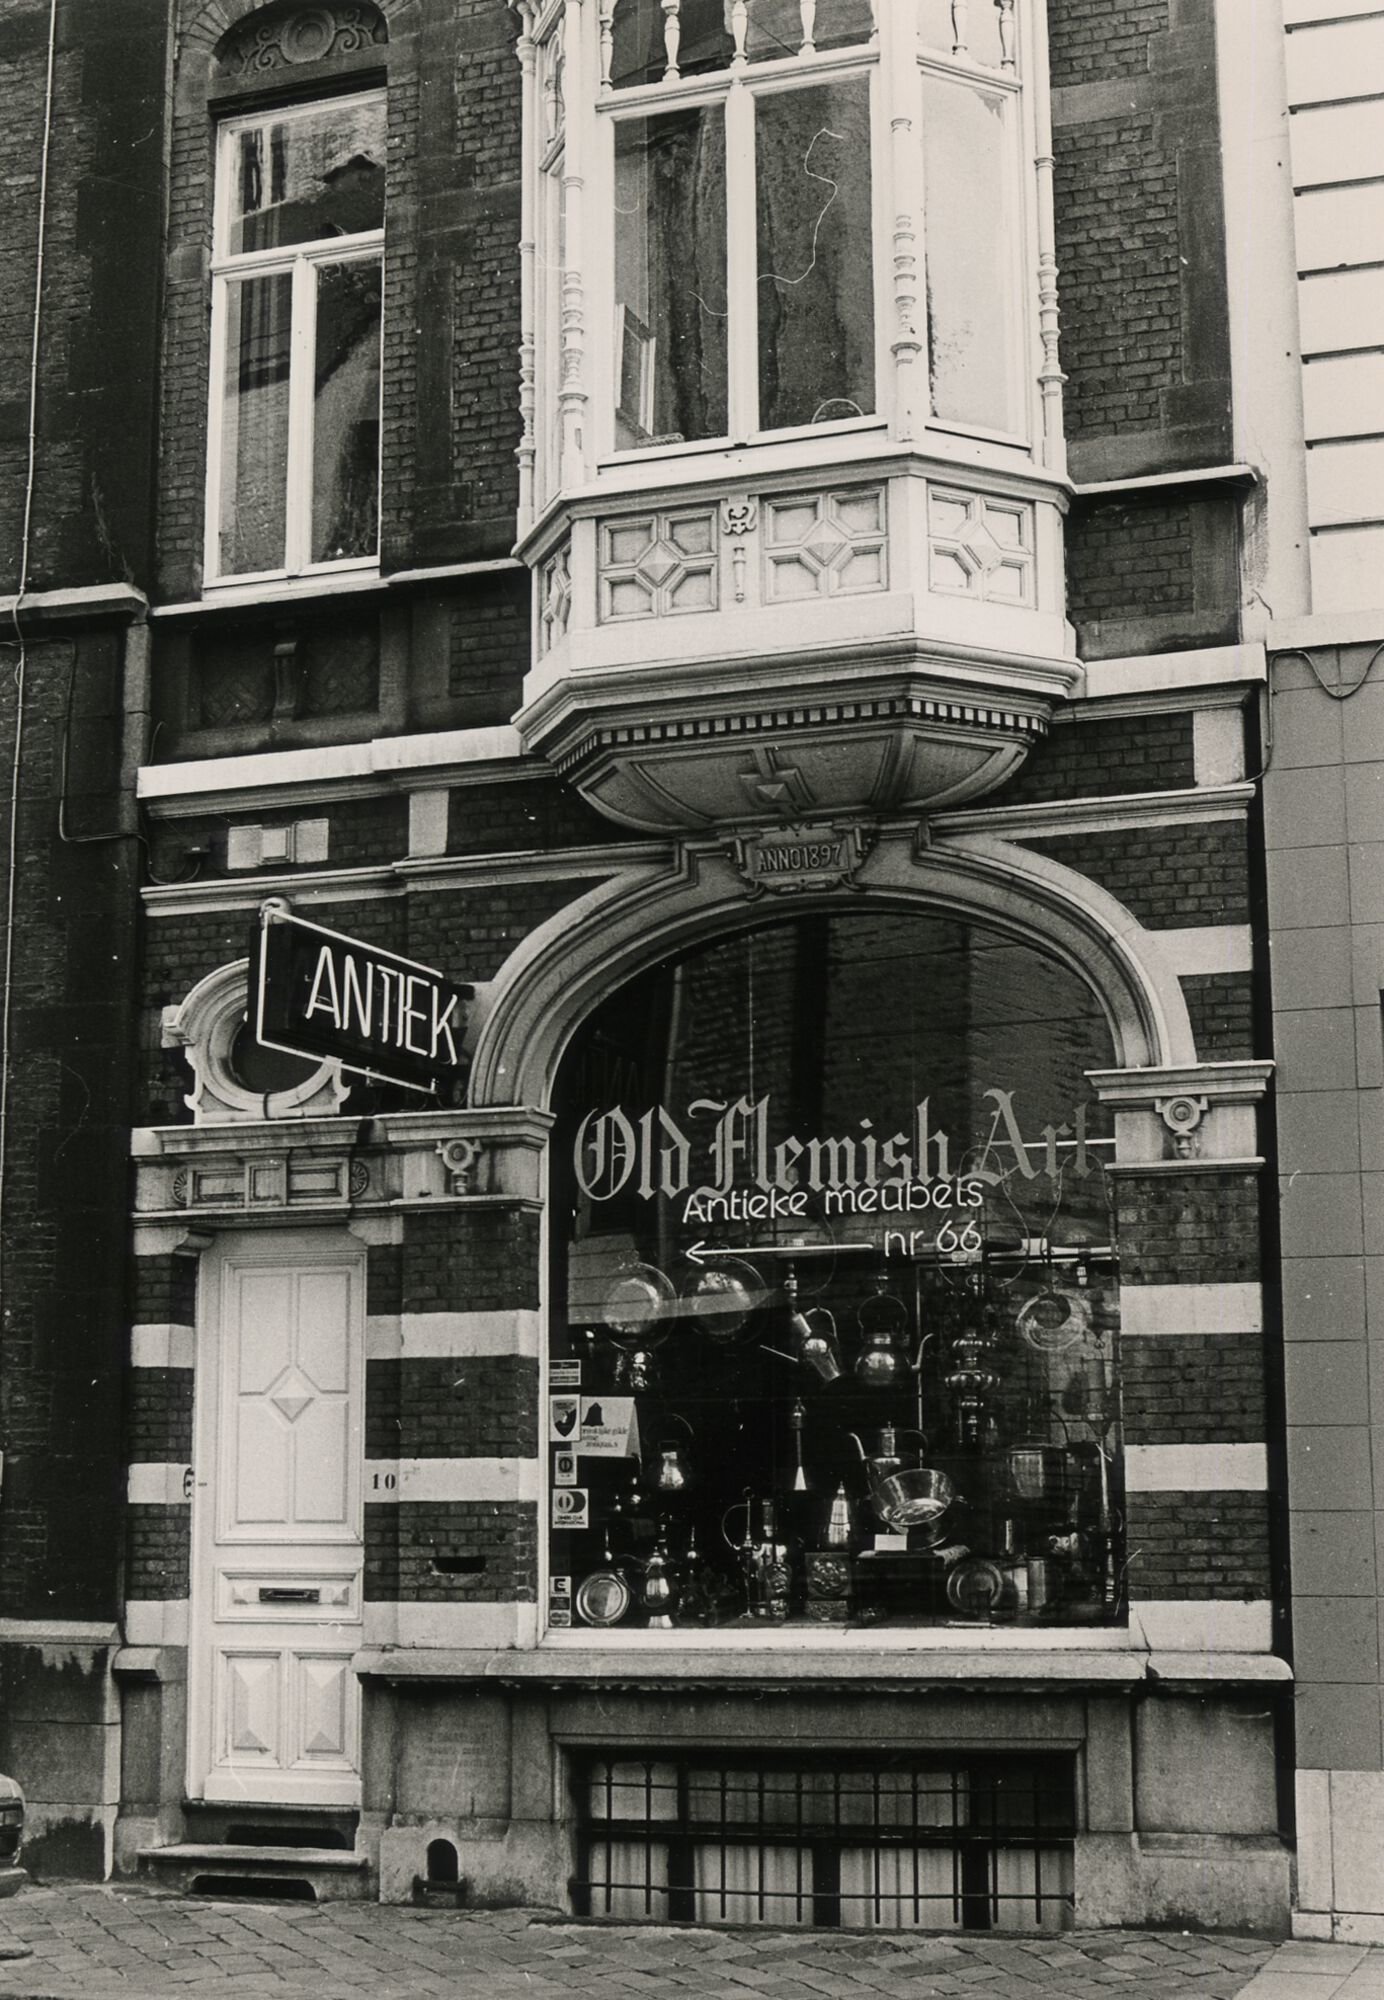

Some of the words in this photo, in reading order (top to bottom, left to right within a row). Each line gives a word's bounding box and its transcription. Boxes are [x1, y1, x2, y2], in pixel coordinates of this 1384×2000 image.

[758, 848, 801, 873] ANNO
[803, 844, 841, 869] 1897
[304, 945, 458, 1066] ANTIEK
[573, 1103, 692, 1201] Old
[688, 1093, 960, 1206] Flemish
[961, 1088, 1097, 1187] Art
[682, 1188, 808, 1223] Antieke
[825, 1178, 984, 1215] meubels
[884, 1230, 925, 1257] nr
[936, 1220, 983, 1252] 66
[373, 1473, 396, 1490] 10
